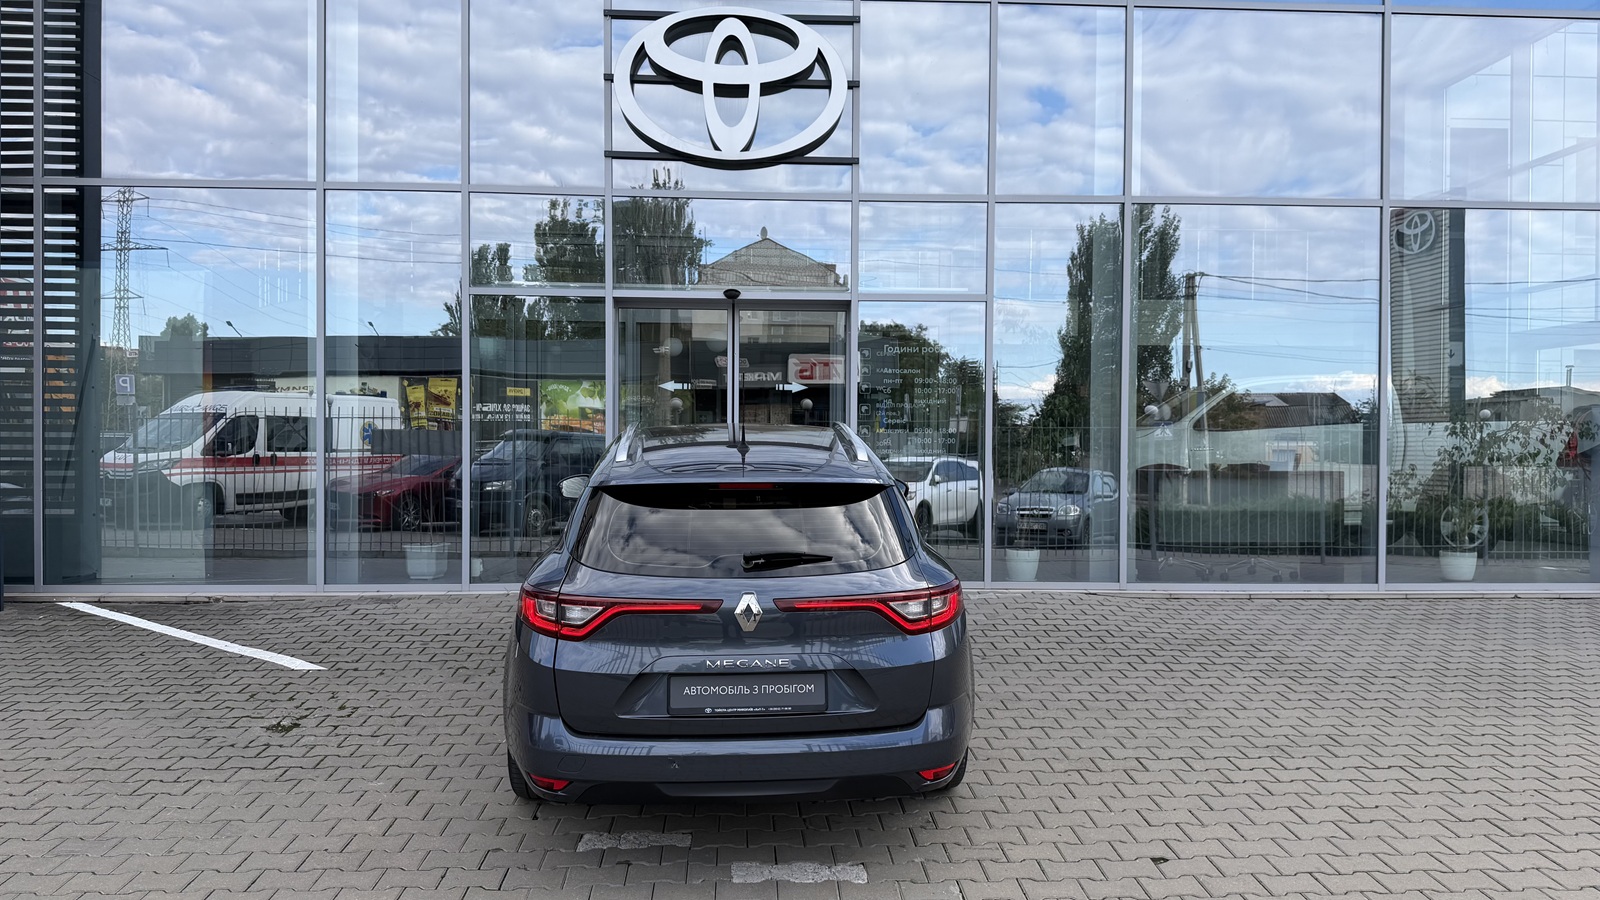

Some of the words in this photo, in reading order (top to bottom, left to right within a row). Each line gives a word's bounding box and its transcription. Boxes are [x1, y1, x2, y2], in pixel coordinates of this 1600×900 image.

[884, 344, 919, 355] Години
[706, 658, 790, 669] MEGANE
[683, 685, 751, 696] АВТОМОБІЛЬ
[752, 685, 759, 695] З
[761, 684, 815, 695] ПРОБІГОМ
